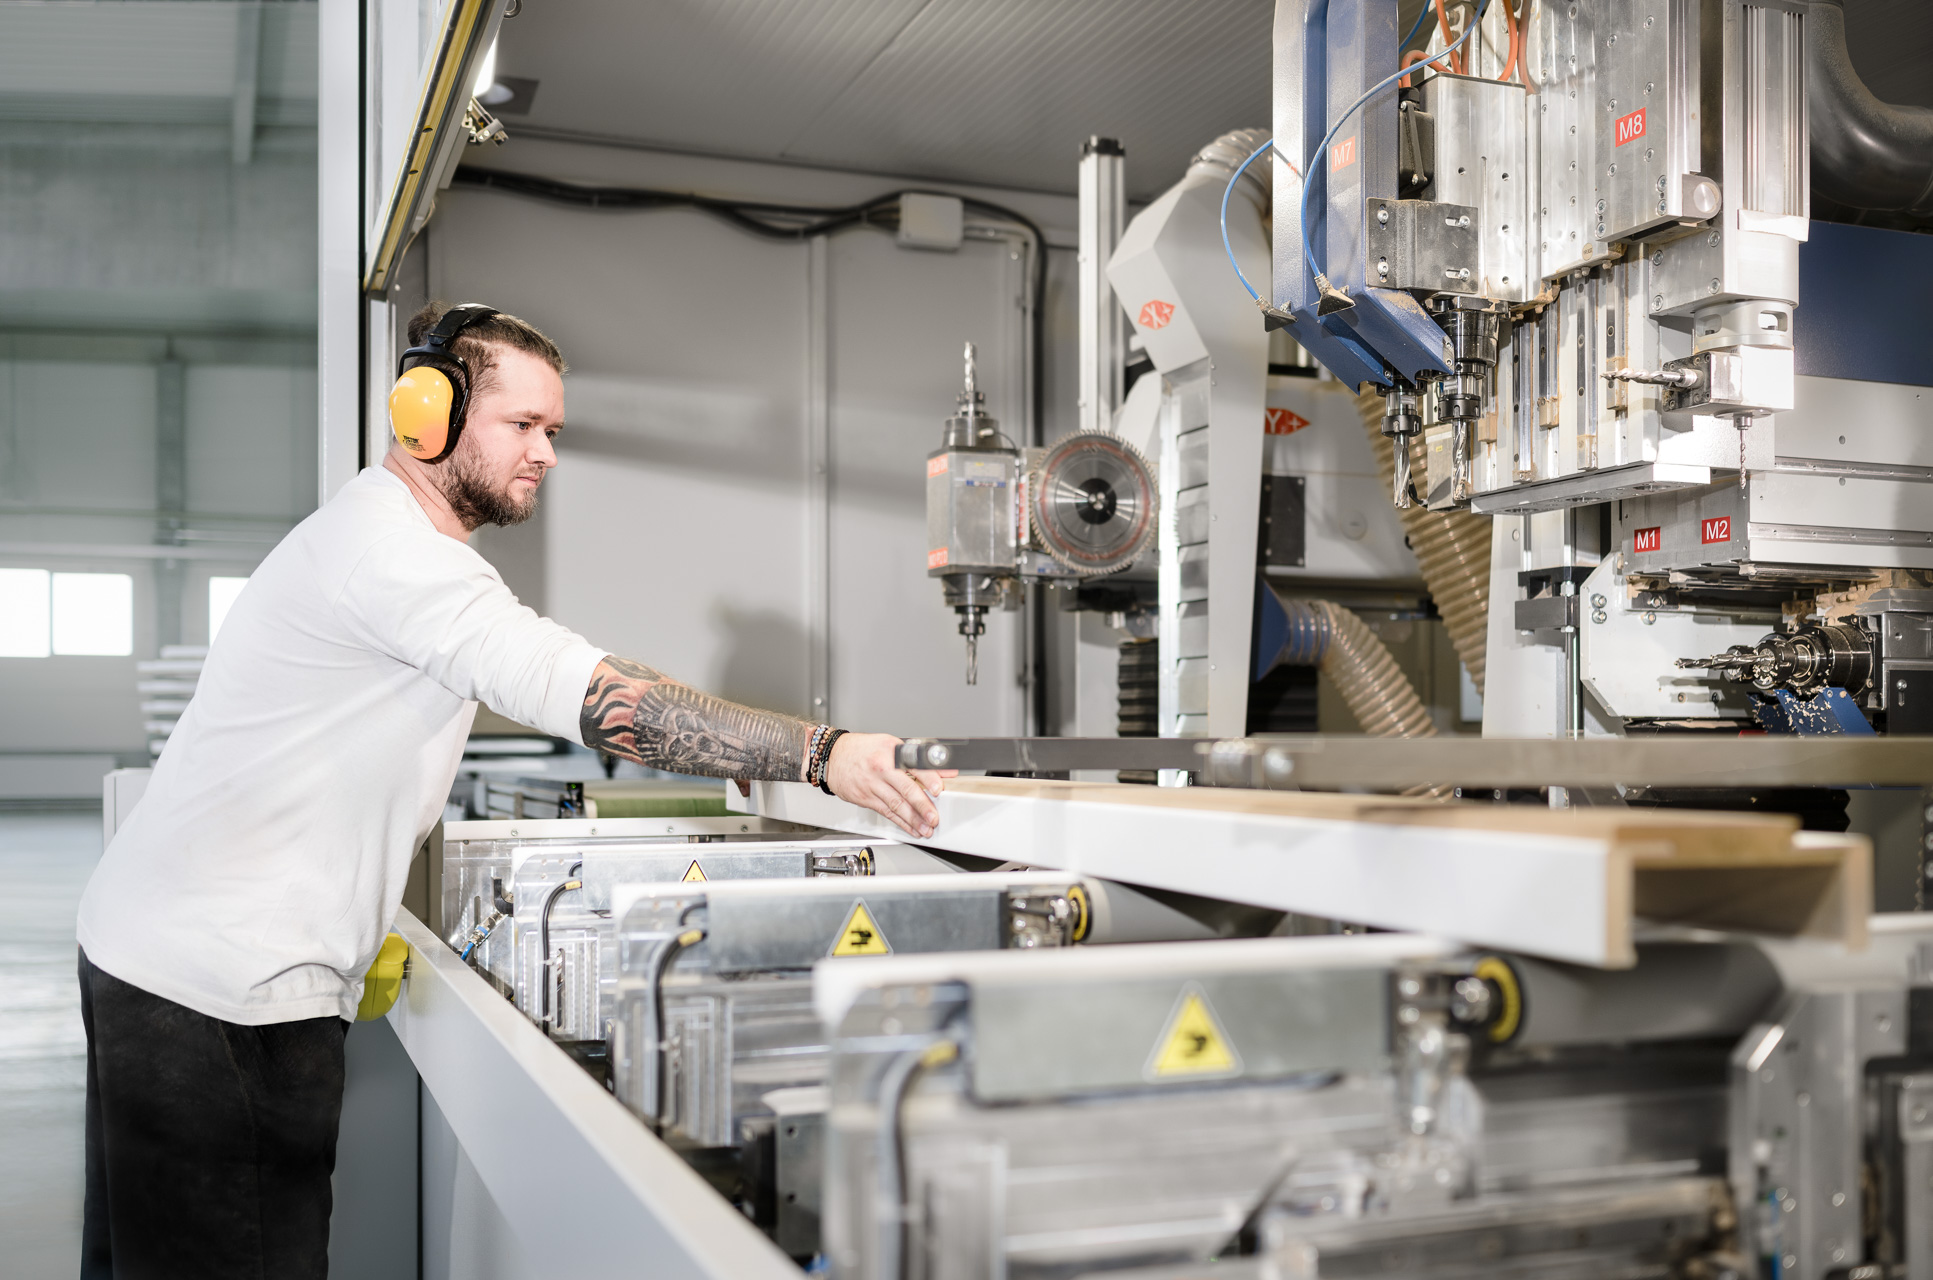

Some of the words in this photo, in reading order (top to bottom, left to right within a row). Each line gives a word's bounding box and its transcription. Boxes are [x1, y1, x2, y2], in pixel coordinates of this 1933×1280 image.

[1620, 114, 1643, 142] M8
[1334, 141, 1352, 167] M7
[1637, 530, 1655, 549] M1
[1706, 520, 1728, 540] M2
